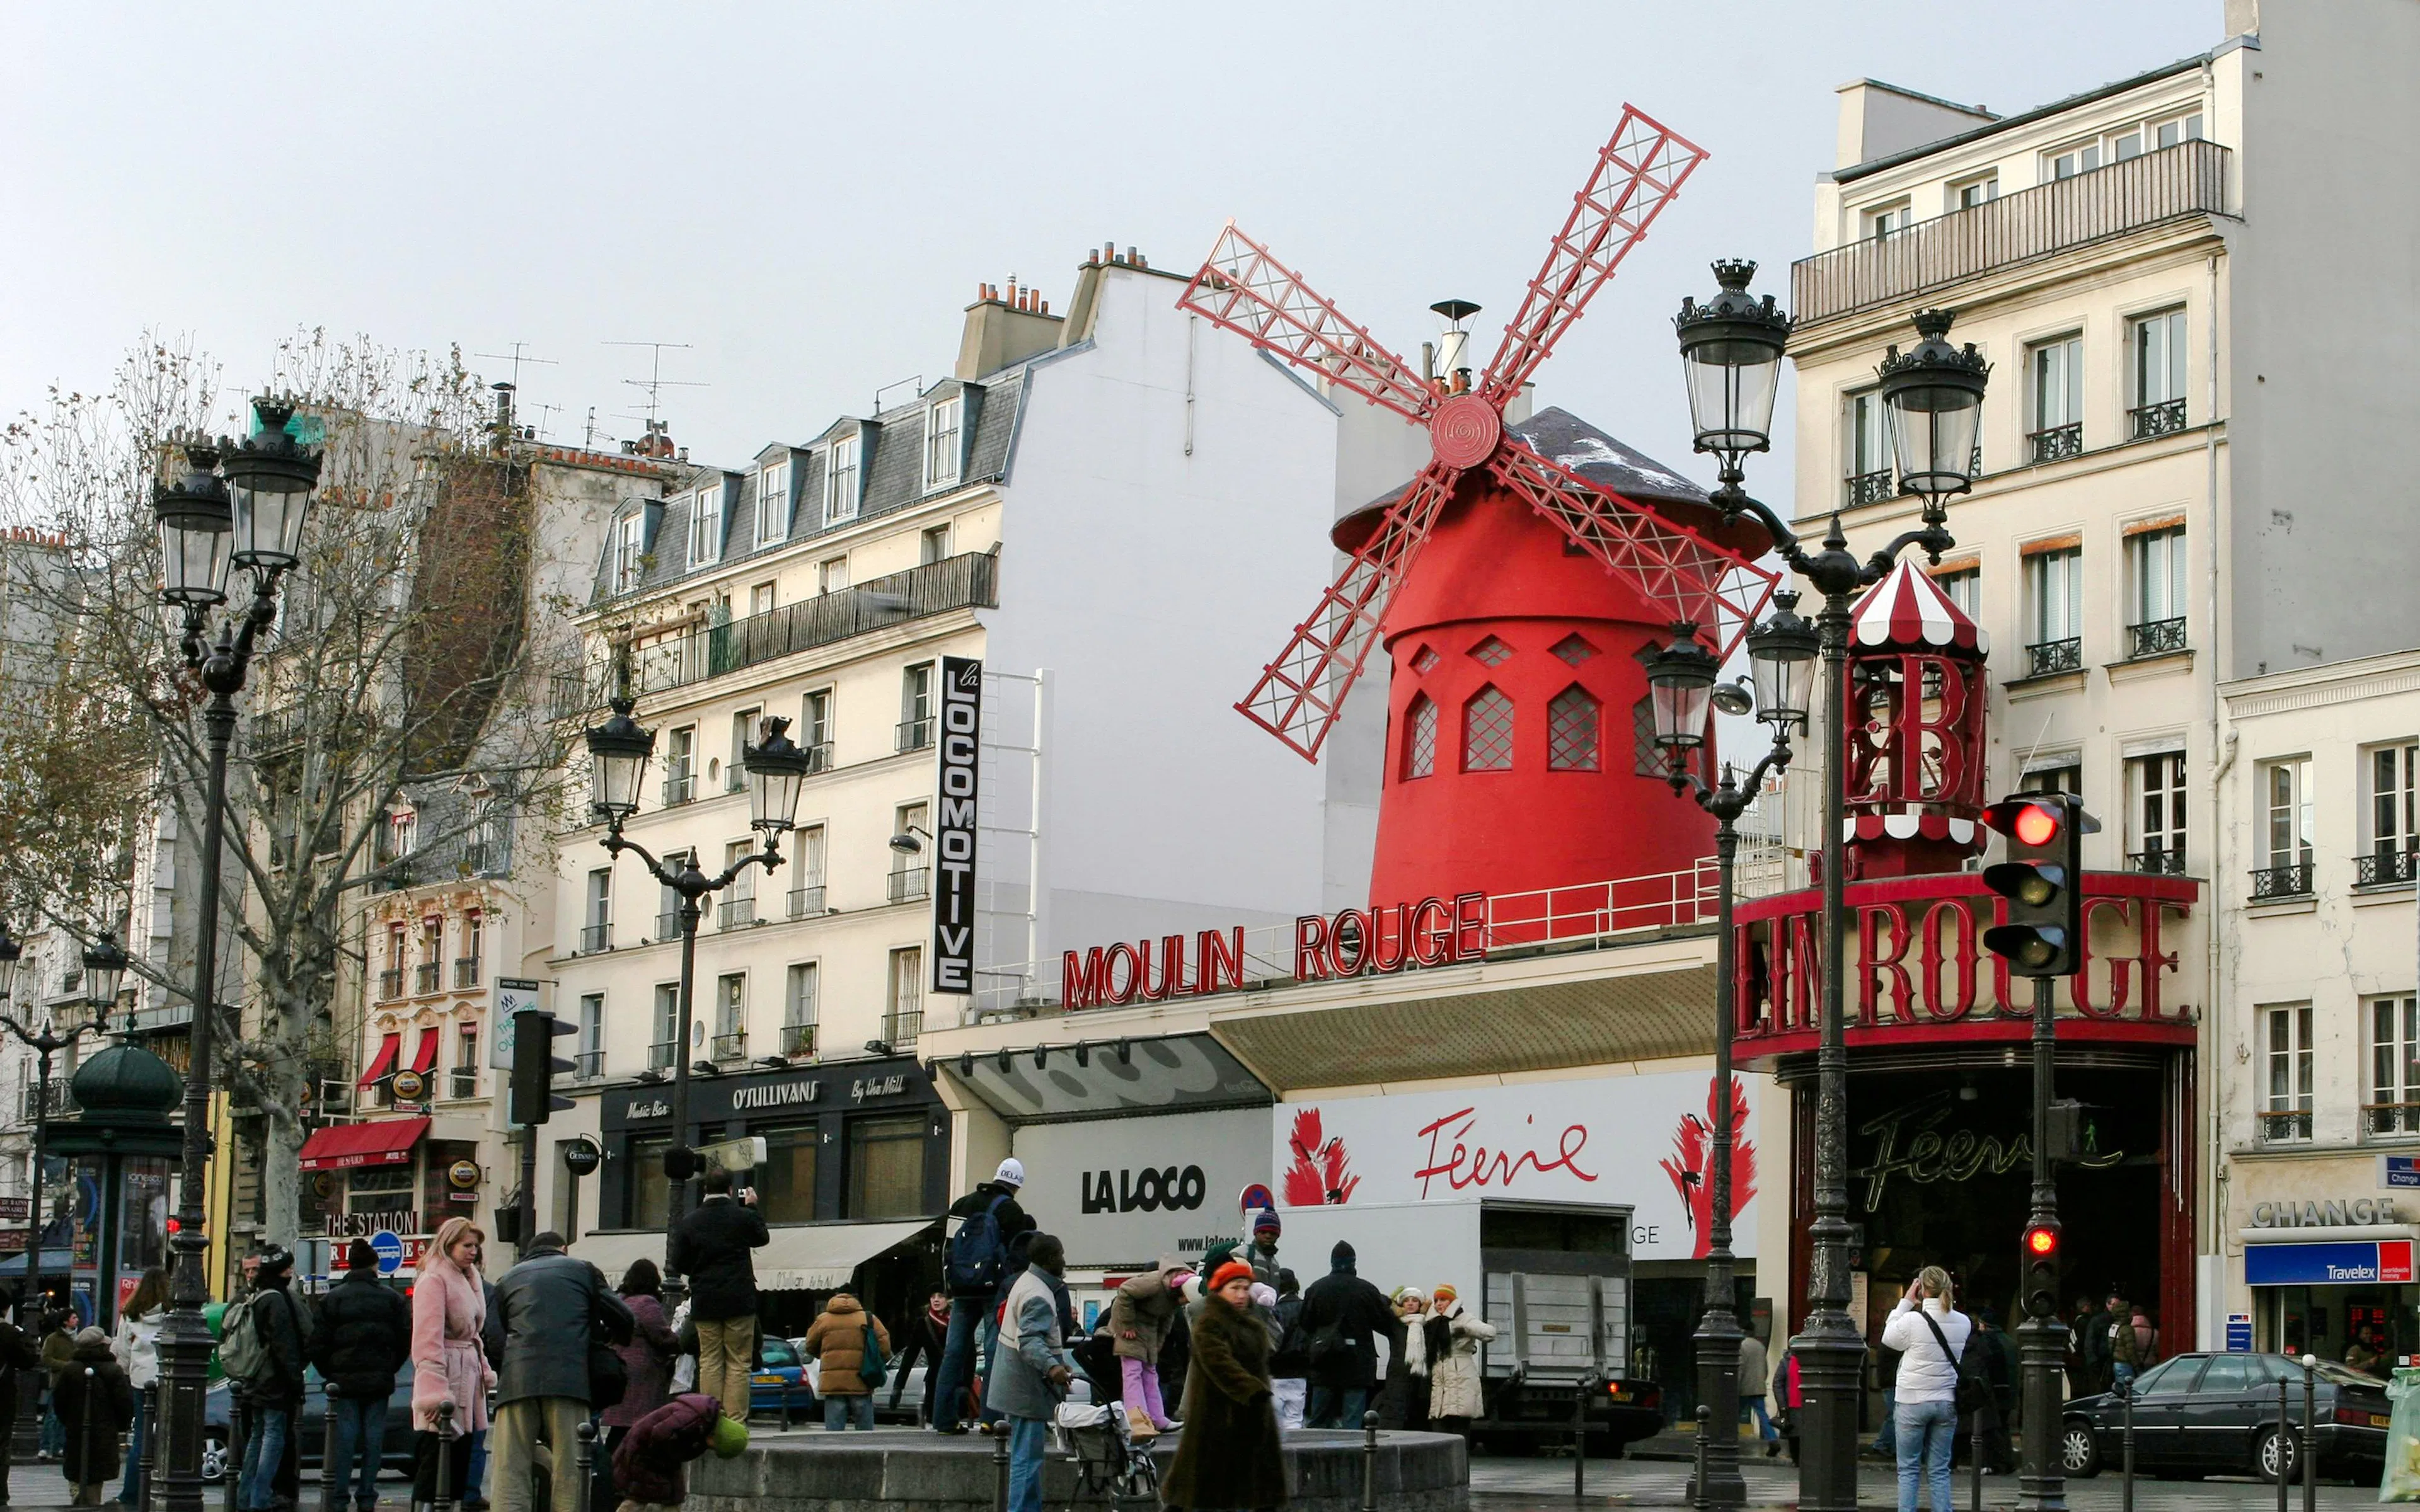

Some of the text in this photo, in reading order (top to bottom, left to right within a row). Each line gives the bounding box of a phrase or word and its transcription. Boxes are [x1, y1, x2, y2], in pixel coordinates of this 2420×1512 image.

[960, 663, 979, 687] la
[938, 670, 976, 988] LOCOMOTIVE
[1063, 891, 1487, 1011] MOULIN ROUGE
[733, 1080, 820, 1110] O'SULLIVANS
[851, 1074, 906, 1103] By the Mill
[626, 1100, 671, 1120] Music Bar
[1414, 1106, 1599, 1200] Féerie
[1081, 1164, 1206, 1215] LA LOCO
[2392, 1173, 2419, 1185] Change
[325, 1210, 414, 1237] THE STATION
[2252, 1198, 2395, 1228] CHANGE
[2327, 1264, 2375, 1280] Travelex
